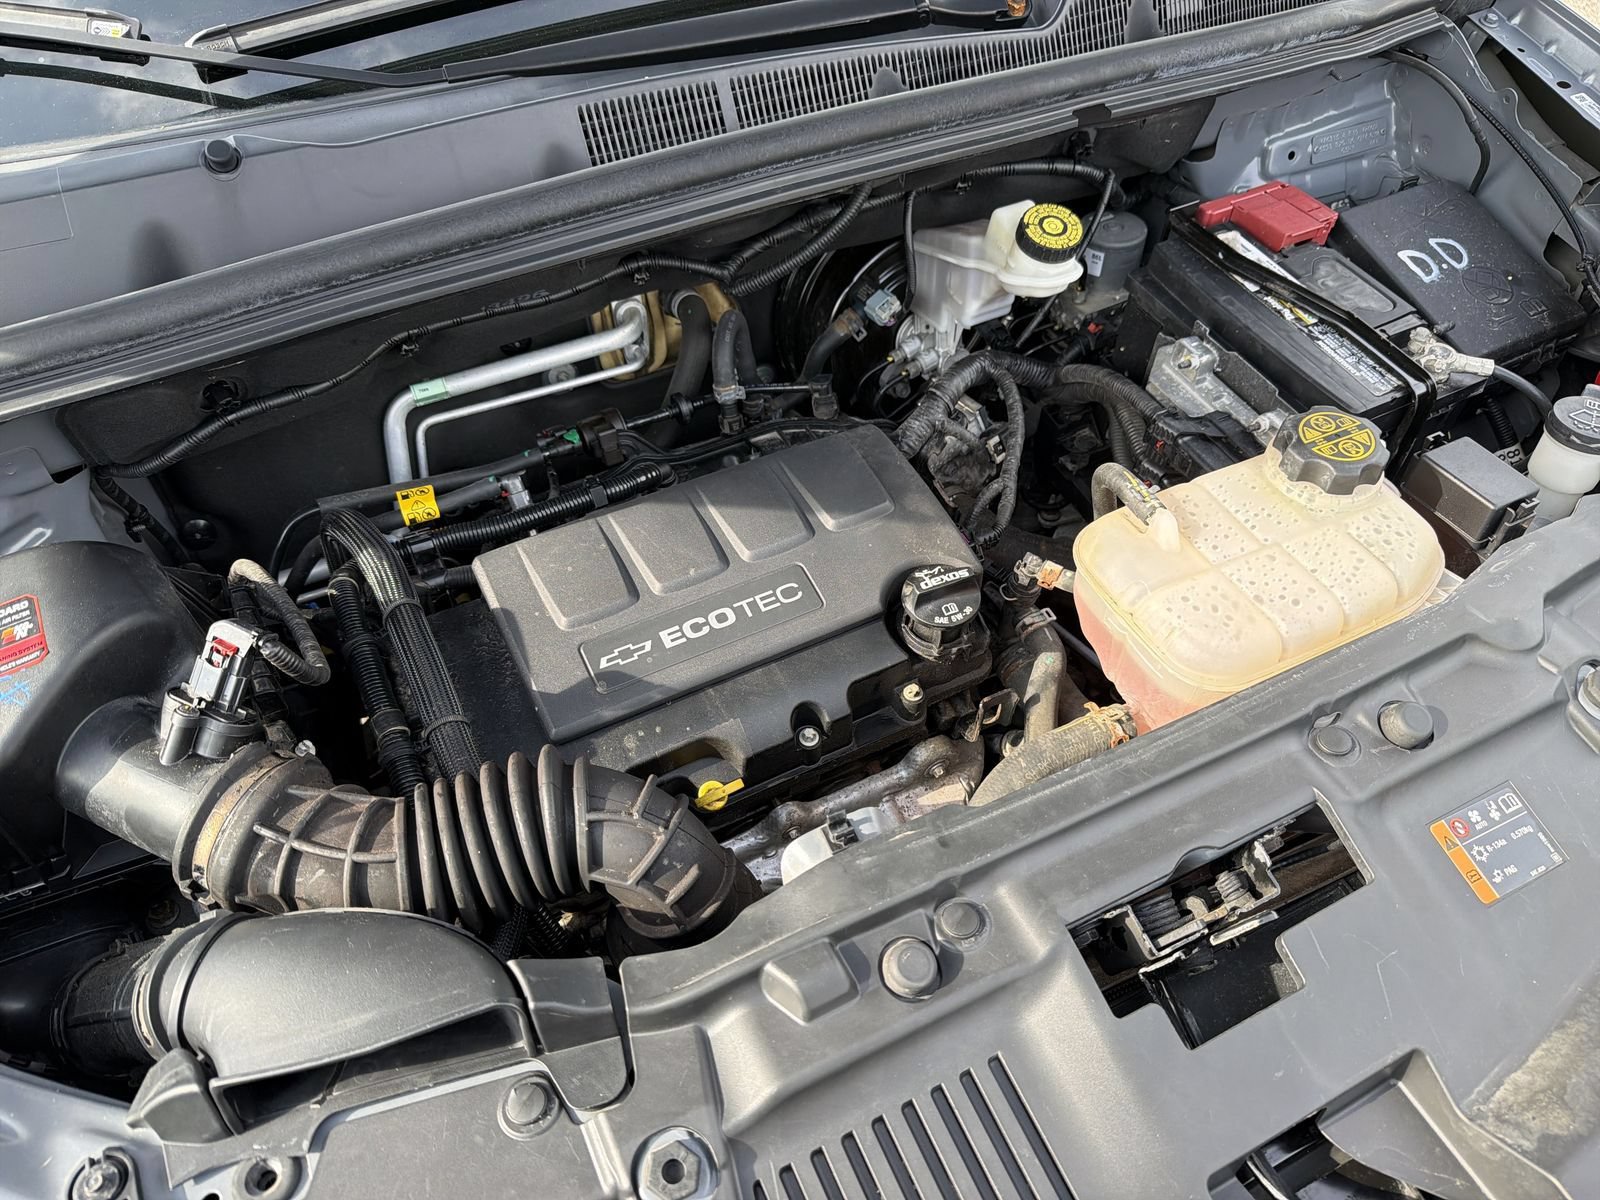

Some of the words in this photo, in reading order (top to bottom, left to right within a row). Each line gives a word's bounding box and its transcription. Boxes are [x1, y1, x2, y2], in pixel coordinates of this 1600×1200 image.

[920, 569, 970, 589] dexos
[11, 609, 31, 621] FILTER
[658, 582, 803, 649] ECOTEC
[934, 616, 950, 624] SAE
[951, 605, 973, 623] 5W-30
[17, 641, 43, 655] SYSTEM
[1475, 820, 1488, 831] AUTO
[1485, 838, 1508, 853] R-134a
[1510, 825, 1534, 840] 0.570kg
[1503, 864, 1518, 877] PAG
